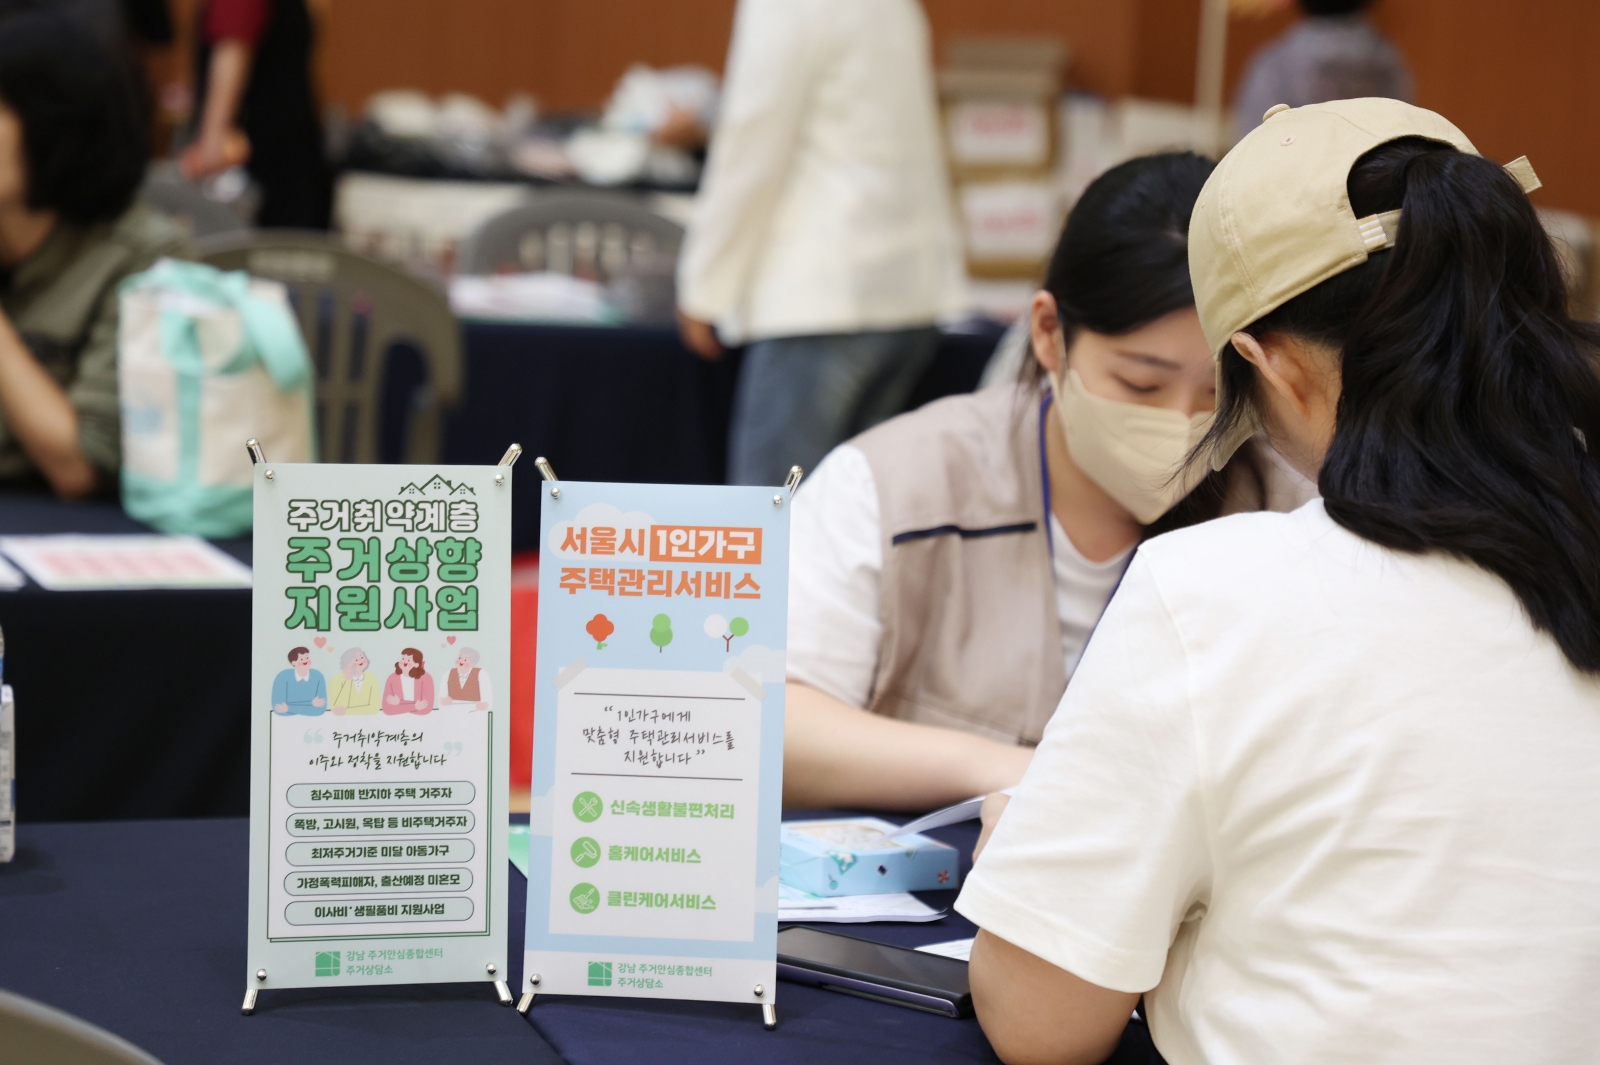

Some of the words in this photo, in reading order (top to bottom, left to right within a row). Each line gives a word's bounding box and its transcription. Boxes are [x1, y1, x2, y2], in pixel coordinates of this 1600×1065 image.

[287, 499, 479, 532] 주거취약계층
[560, 526, 645, 557] 서울시
[656, 529, 756, 560] 1인가구
[286, 536, 483, 583] 주거상향
[559, 566, 762, 599] 주택관리서비스
[284, 585, 479, 632] 지원사업
[332, 729, 424, 749] 주거취약계층의
[583, 726, 620, 746] 맞춤형
[629, 729, 735, 751] 주택관리서비스를
[309, 754, 344, 771] 이주와
[347, 751, 382, 770] 정착을
[386, 751, 447, 770] 지원합니다
[310, 789, 355, 801] 침수피해
[358, 788, 391, 800] 반지하
[394, 788, 416, 799] 주택
[419, 787, 452, 799] 거주자
[610, 799, 735, 820] 신속생활불편처리
[323, 818, 359, 831] 고시원,
[362, 817, 385, 829] 옥탑
[387, 817, 398, 828] 등
[401, 816, 468, 828] 비주택거주자
[311, 846, 378, 859] 최저주거기준
[381, 846, 403, 857] 미달
[406, 845, 449, 857] 아동가구
[608, 845, 702, 864] 홈케어서비스
[297, 876, 378, 889] 가정폭력피해자,
[381, 875, 424, 887] 출산예정
[427, 874, 460, 885] 미혼모
[401, 903, 445, 915] 지원사업
[607, 890, 717, 911] 클린케어서비스
[346, 950, 365, 962] 강남
[367, 947, 443, 961] 주거안심종합센터
[346, 964, 394, 976] 주거상담소
[617, 962, 636, 974] 강남
[638, 963, 713, 977] 주거안심종합센터
[617, 977, 664, 989] 주거상담소
